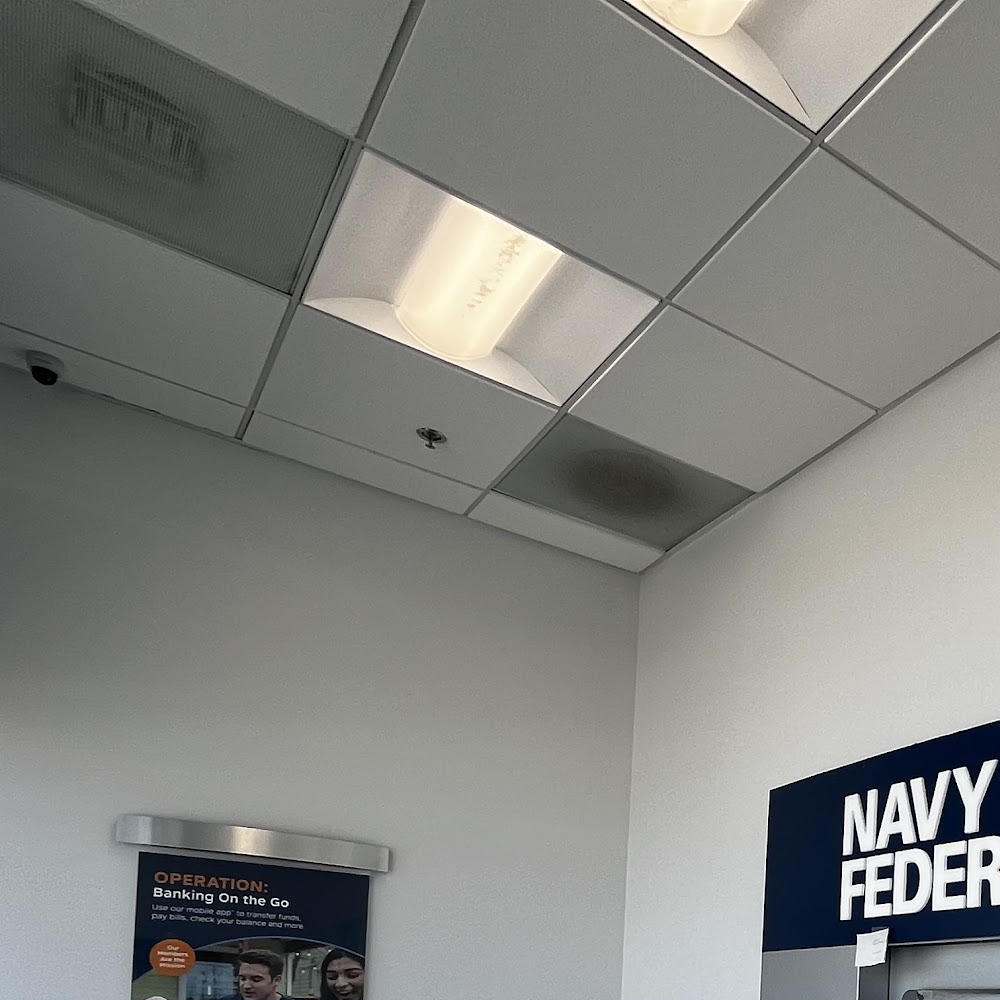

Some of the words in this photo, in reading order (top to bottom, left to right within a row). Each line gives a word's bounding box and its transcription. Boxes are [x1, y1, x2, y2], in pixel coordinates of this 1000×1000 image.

[842, 759, 999, 856] NAVY
[154, 871, 269, 893] OPERATION:
[153, 887, 214, 904] Banking
[218, 892, 239, 904] On
[243, 895, 267, 906] the
[270, 897, 290, 908] Go
[151, 903, 169, 911] Use
[186, 906, 214, 915] mobile
[246, 911, 276, 920] transfer
[151, 912, 167, 921] pay
[190, 914, 215, 923] check
[216, 917, 234, 926] your
[236, 918, 267, 927] balance
[268, 920, 283, 928] and
